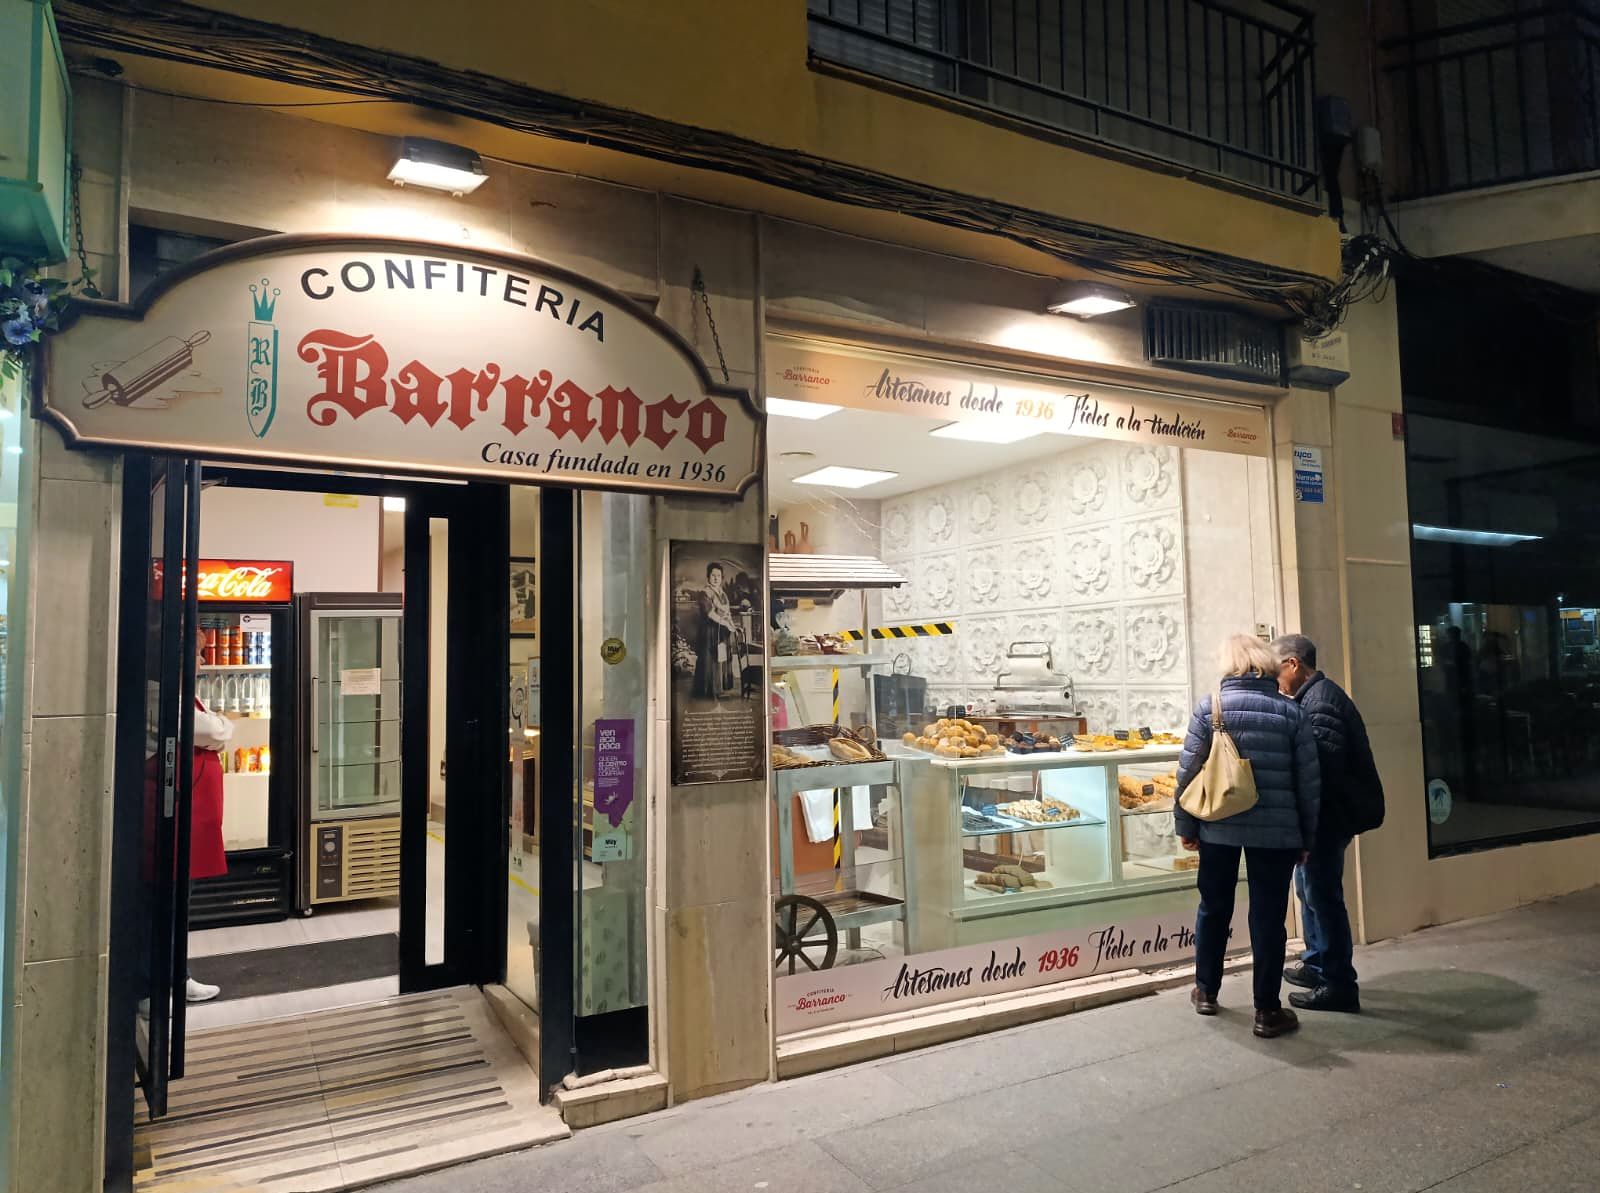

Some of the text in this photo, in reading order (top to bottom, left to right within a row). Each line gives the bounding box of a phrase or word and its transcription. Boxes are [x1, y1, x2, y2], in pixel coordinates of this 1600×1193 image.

[300, 257, 606, 343] CONFITERIA
[297, 328, 728, 456] Barranco
[783, 368, 830, 385] Barranco
[863, 367, 951, 406] Artesanos
[959, 380, 1004, 414] desde
[1015, 399, 1055, 420] 1936
[1116, 416, 1126, 430] a
[1127, 405, 1141, 432] la
[1144, 412, 1206, 441] tradición
[481, 442, 727, 483] Casa fundada en 1936
[881, 963, 973, 1000] Artesanos
[981, 946, 1027, 983] desde
[1038, 945, 1080, 973] 1936
[1088, 925, 1136, 973] Fieles
[1142, 937, 1151, 954] a
[1154, 924, 1168, 953] la
[796, 993, 846, 1010] Barranco
